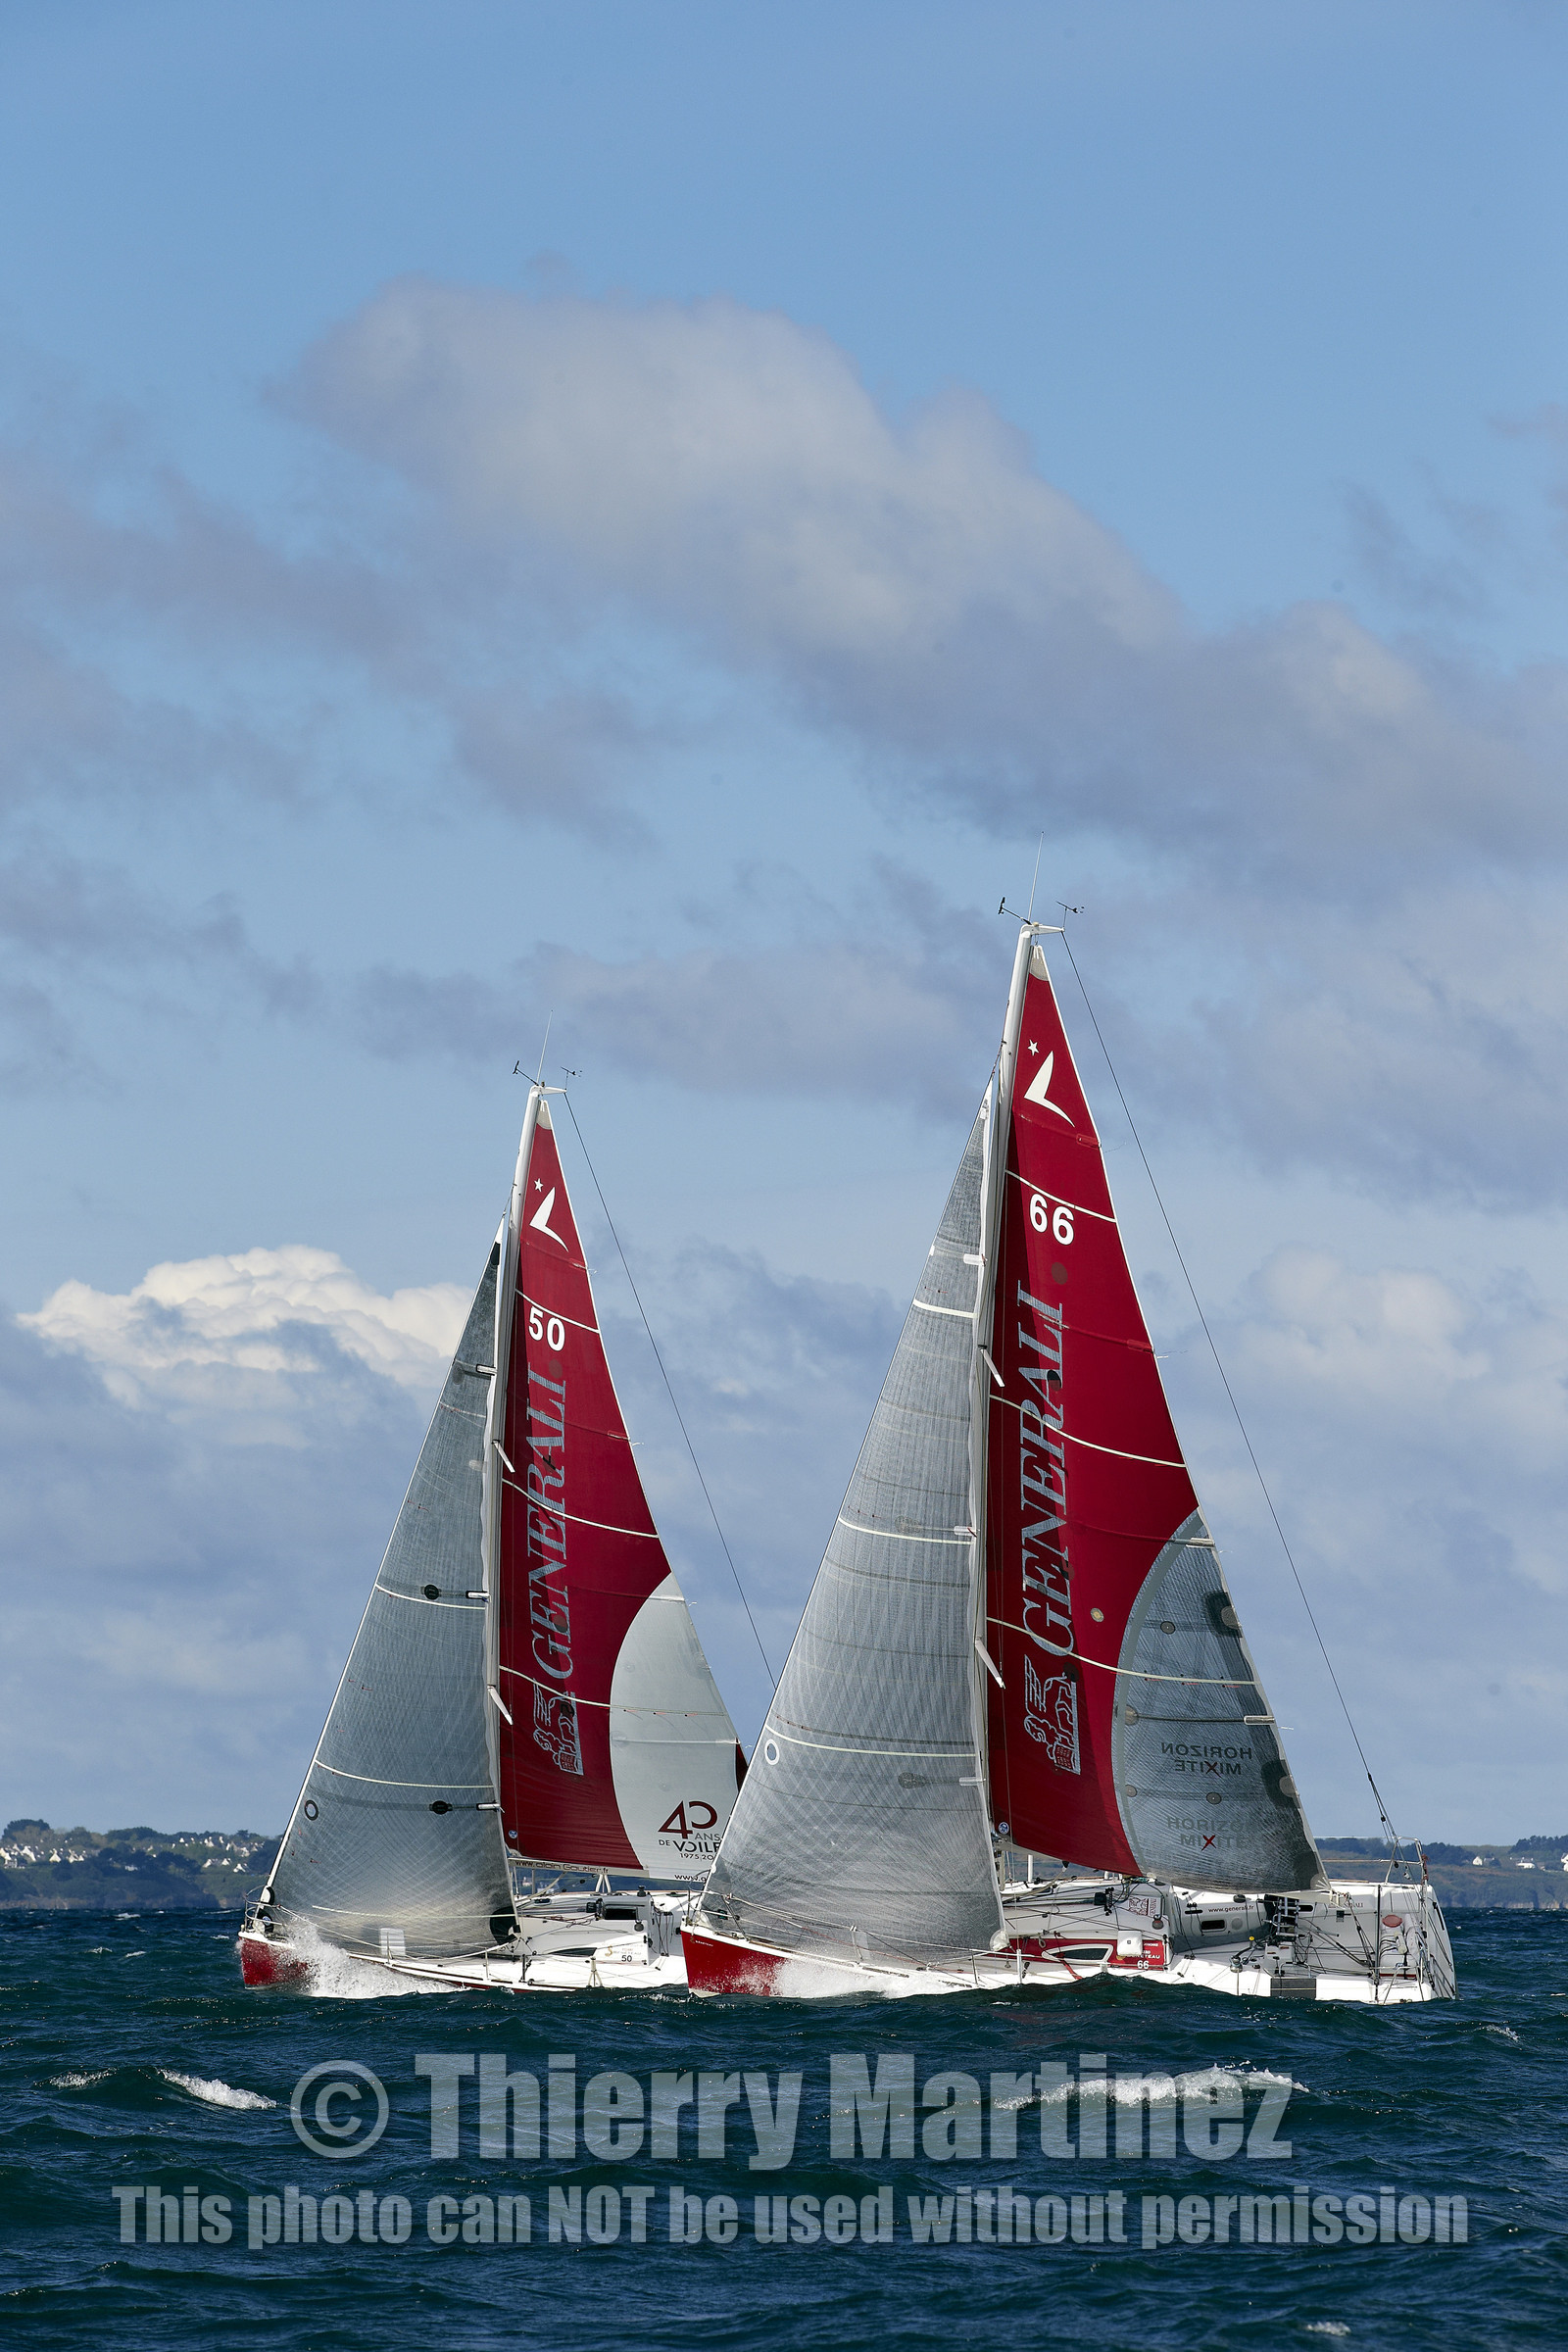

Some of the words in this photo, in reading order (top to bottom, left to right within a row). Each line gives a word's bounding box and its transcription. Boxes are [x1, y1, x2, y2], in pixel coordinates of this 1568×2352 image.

[1029, 1193, 1075, 1246] 66
[527, 1304, 565, 1351] 50
[1016, 1279, 1075, 1656] GENERALI
[526, 1361, 574, 1680] GENERALI
[659, 1838, 670, 1847] DE
[694, 1832, 722, 1841] ANS
[621, 1954, 633, 1963] 50
[1137, 1959, 1150, 1970] 66
